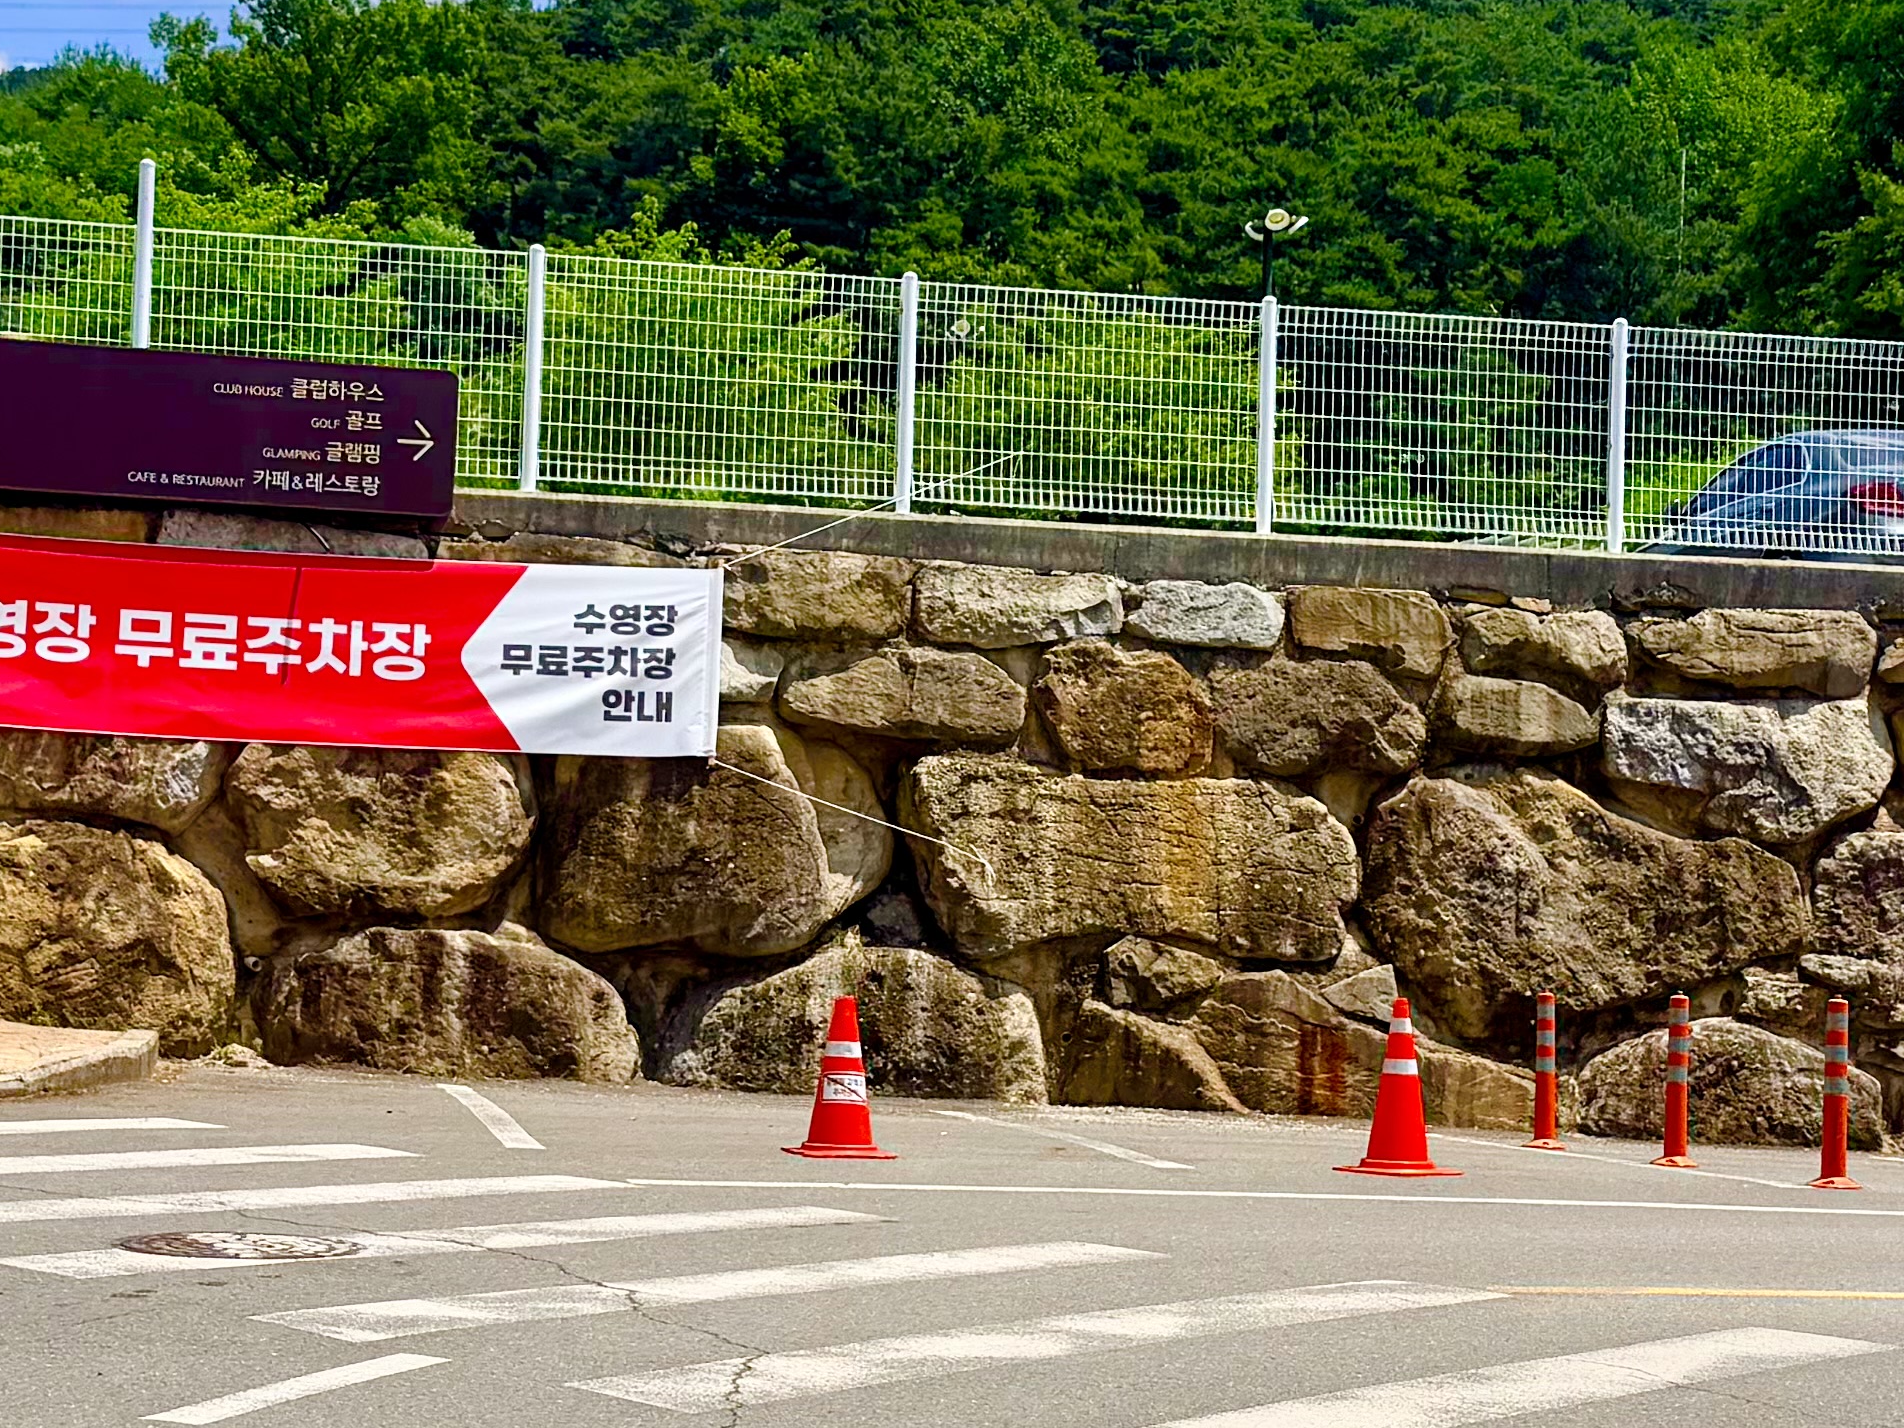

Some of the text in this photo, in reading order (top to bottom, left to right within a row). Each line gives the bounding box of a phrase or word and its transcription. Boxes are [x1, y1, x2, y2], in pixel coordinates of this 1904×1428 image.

[213, 377, 385, 402] CLUB HOUSE 클럽하우스
[311, 410, 383, 431] GOLF 골프
[262, 441, 380, 465] GLAMPING 글램핑
[127, 470, 381, 497] CAFE & RESTAURANT 카페&레스토랑
[573, 604, 678, 636] 수영장
[114, 608, 432, 681] 무료주차장
[501, 644, 677, 680] 무료주차장
[602, 689, 673, 722] 안내
